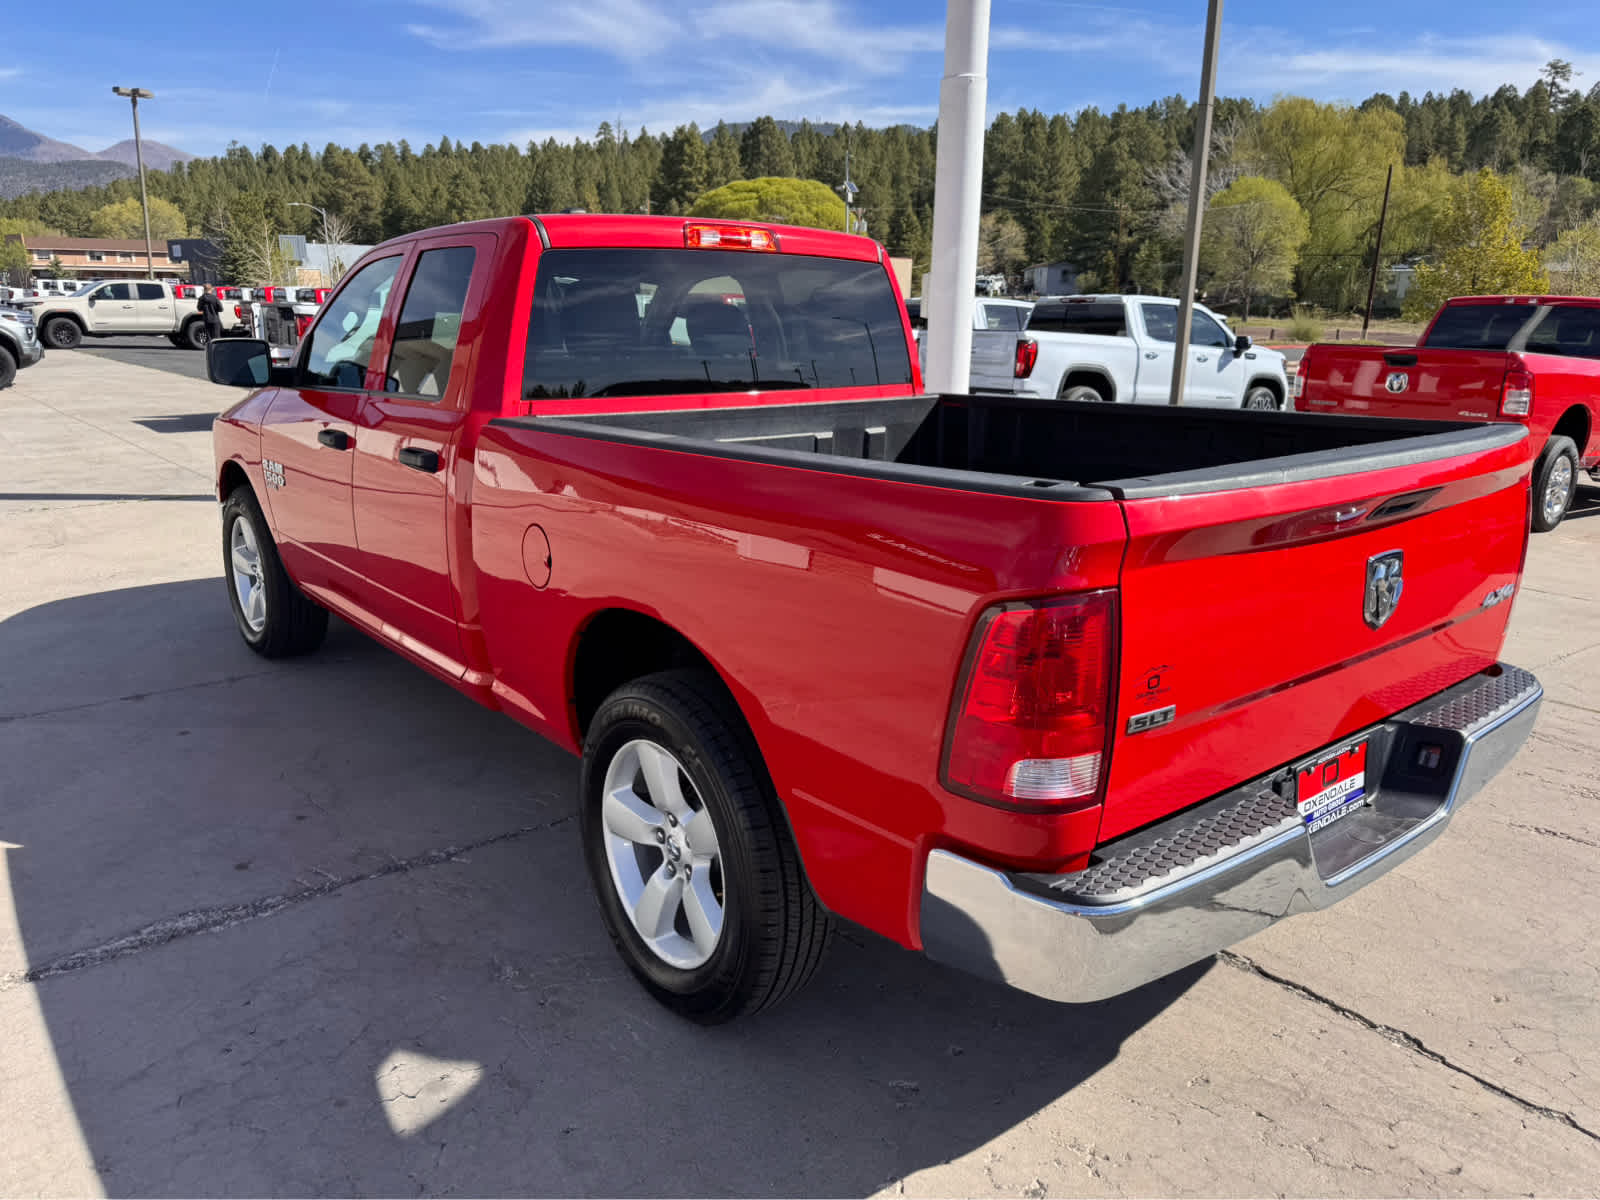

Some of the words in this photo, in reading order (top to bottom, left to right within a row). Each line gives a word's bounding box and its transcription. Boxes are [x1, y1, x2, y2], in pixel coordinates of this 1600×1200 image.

[264, 470, 285, 487] 1500
[1134, 710, 1174, 730] SLT
[1303, 778, 1356, 812] OXENDALE
[1312, 806, 1328, 820] AUTO
[1327, 795, 1346, 810] GROUP
